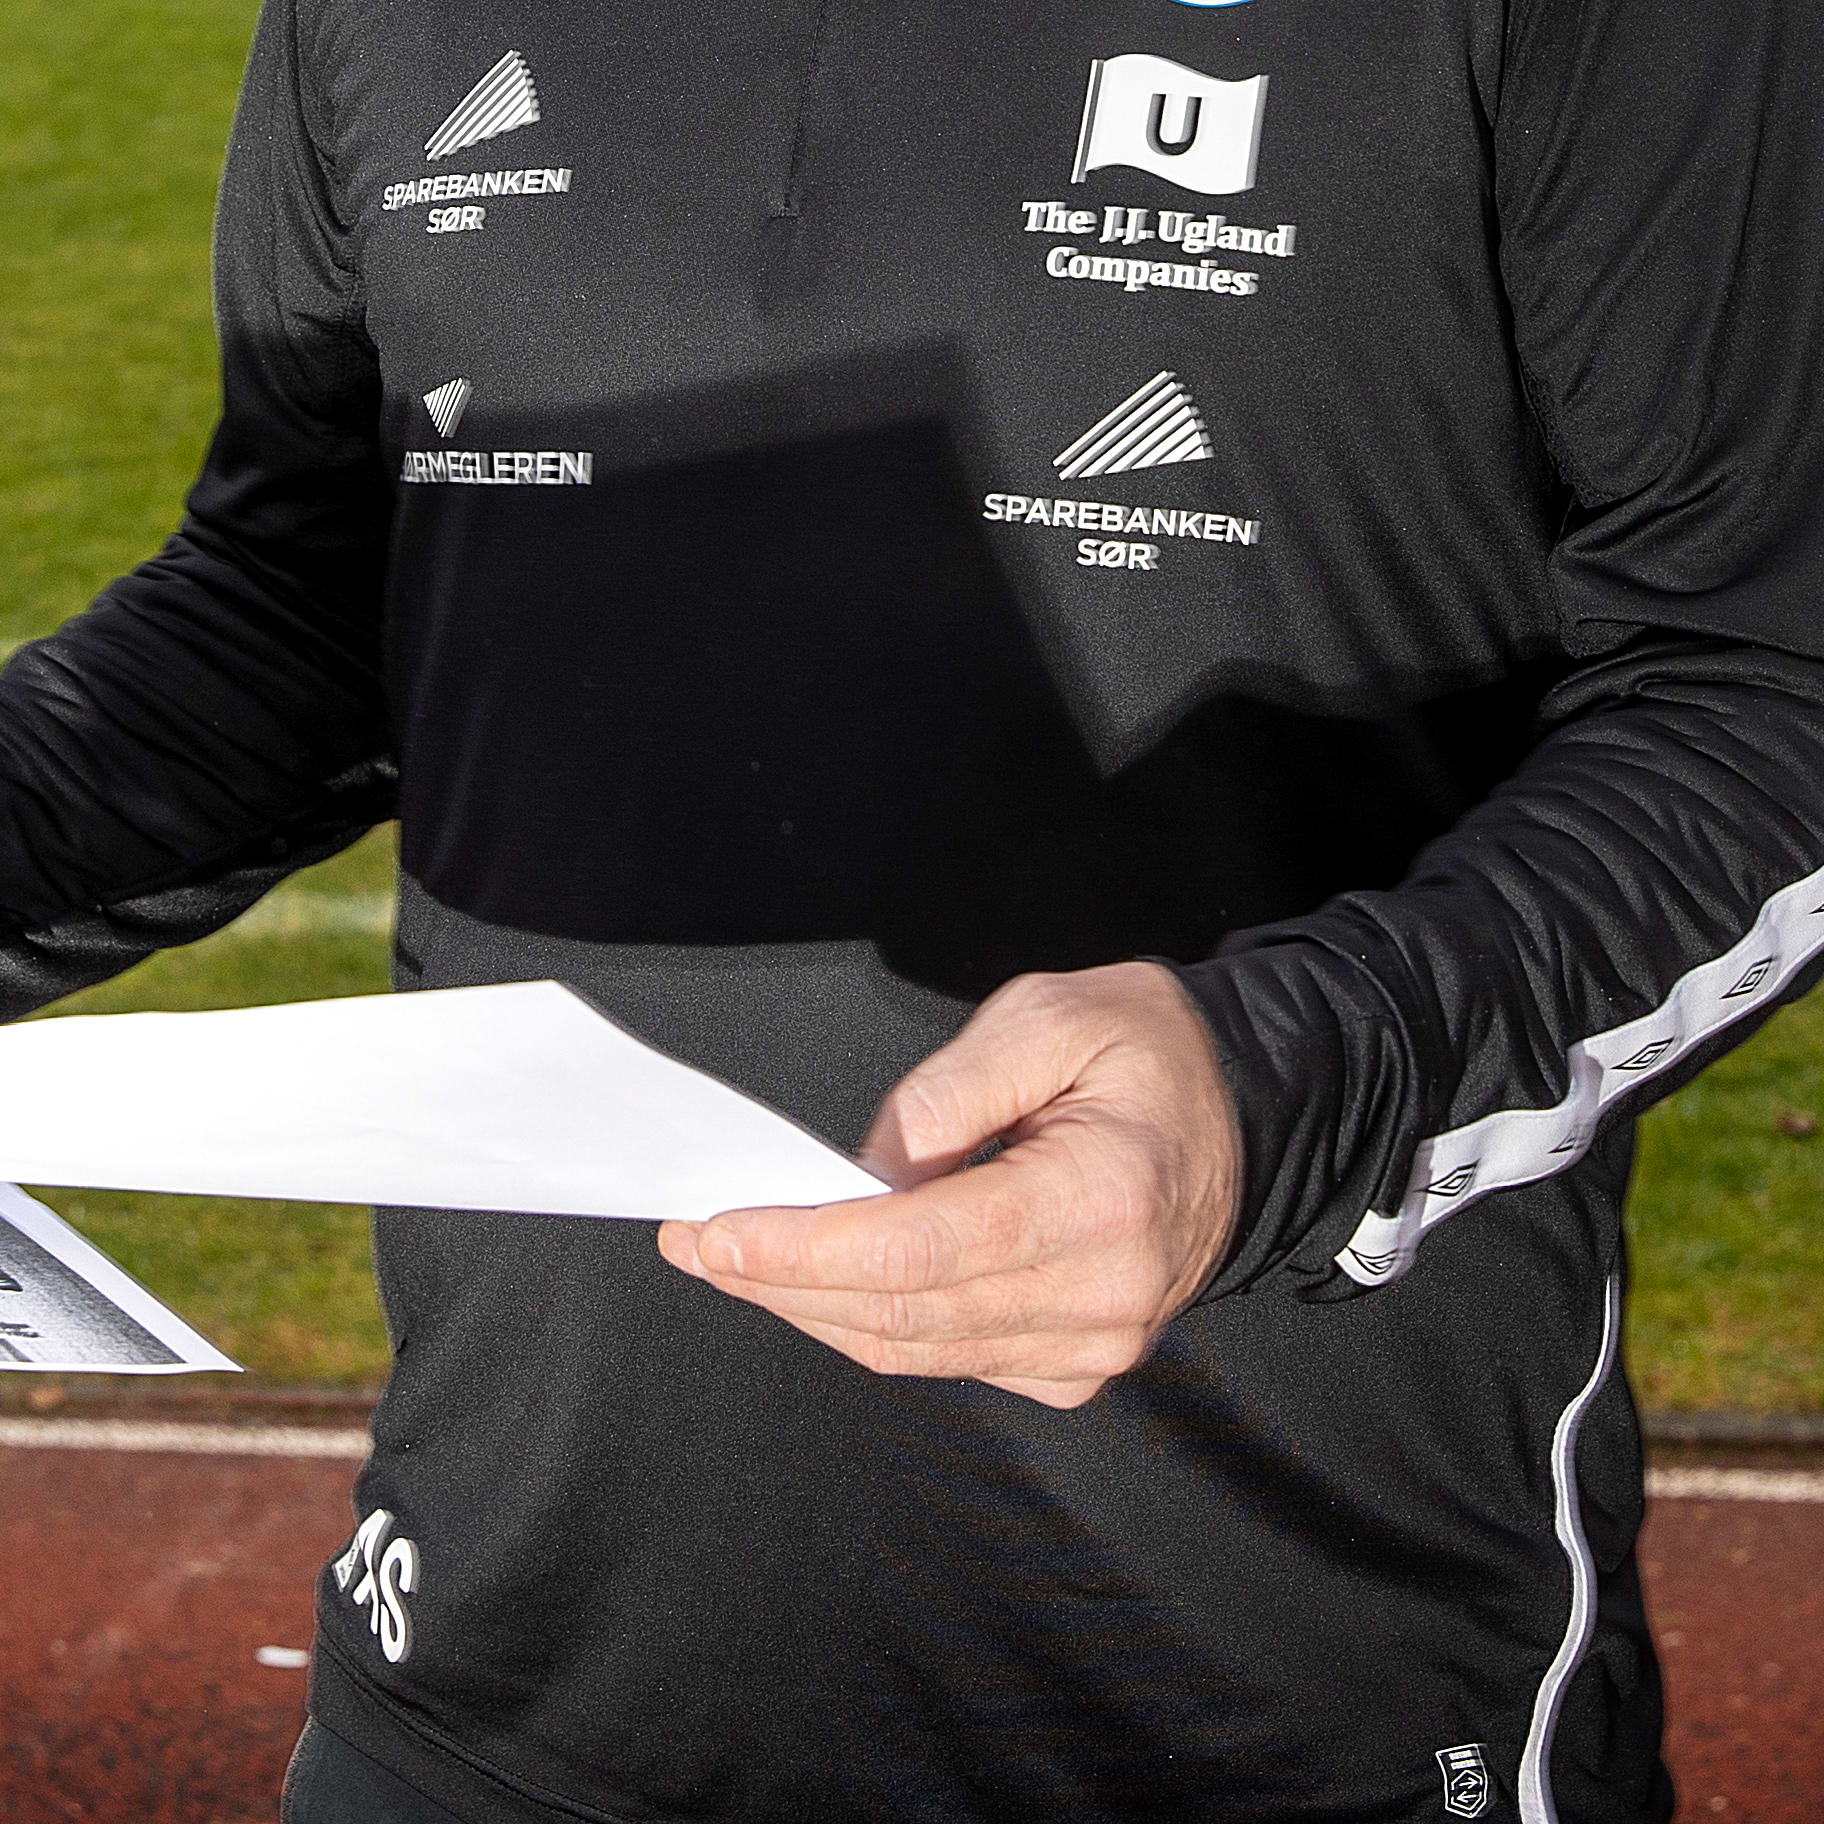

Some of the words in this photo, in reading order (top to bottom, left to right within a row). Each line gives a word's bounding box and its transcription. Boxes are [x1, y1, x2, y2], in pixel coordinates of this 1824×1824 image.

[1145, 92, 1204, 156] U
[381, 167, 573, 211] SPAREBANKEN
[426, 205, 486, 234] SØR
[1021, 200, 1098, 234] The
[1098, 205, 1155, 245] J.J.
[1157, 209, 1297, 258] Ugland
[1045, 245, 1260, 296] Companies
[400, 450, 594, 485] ØRMEGLEREN
[982, 492, 1261, 546] SPAREBANKEN
[1076, 538, 1161, 571] SØR
